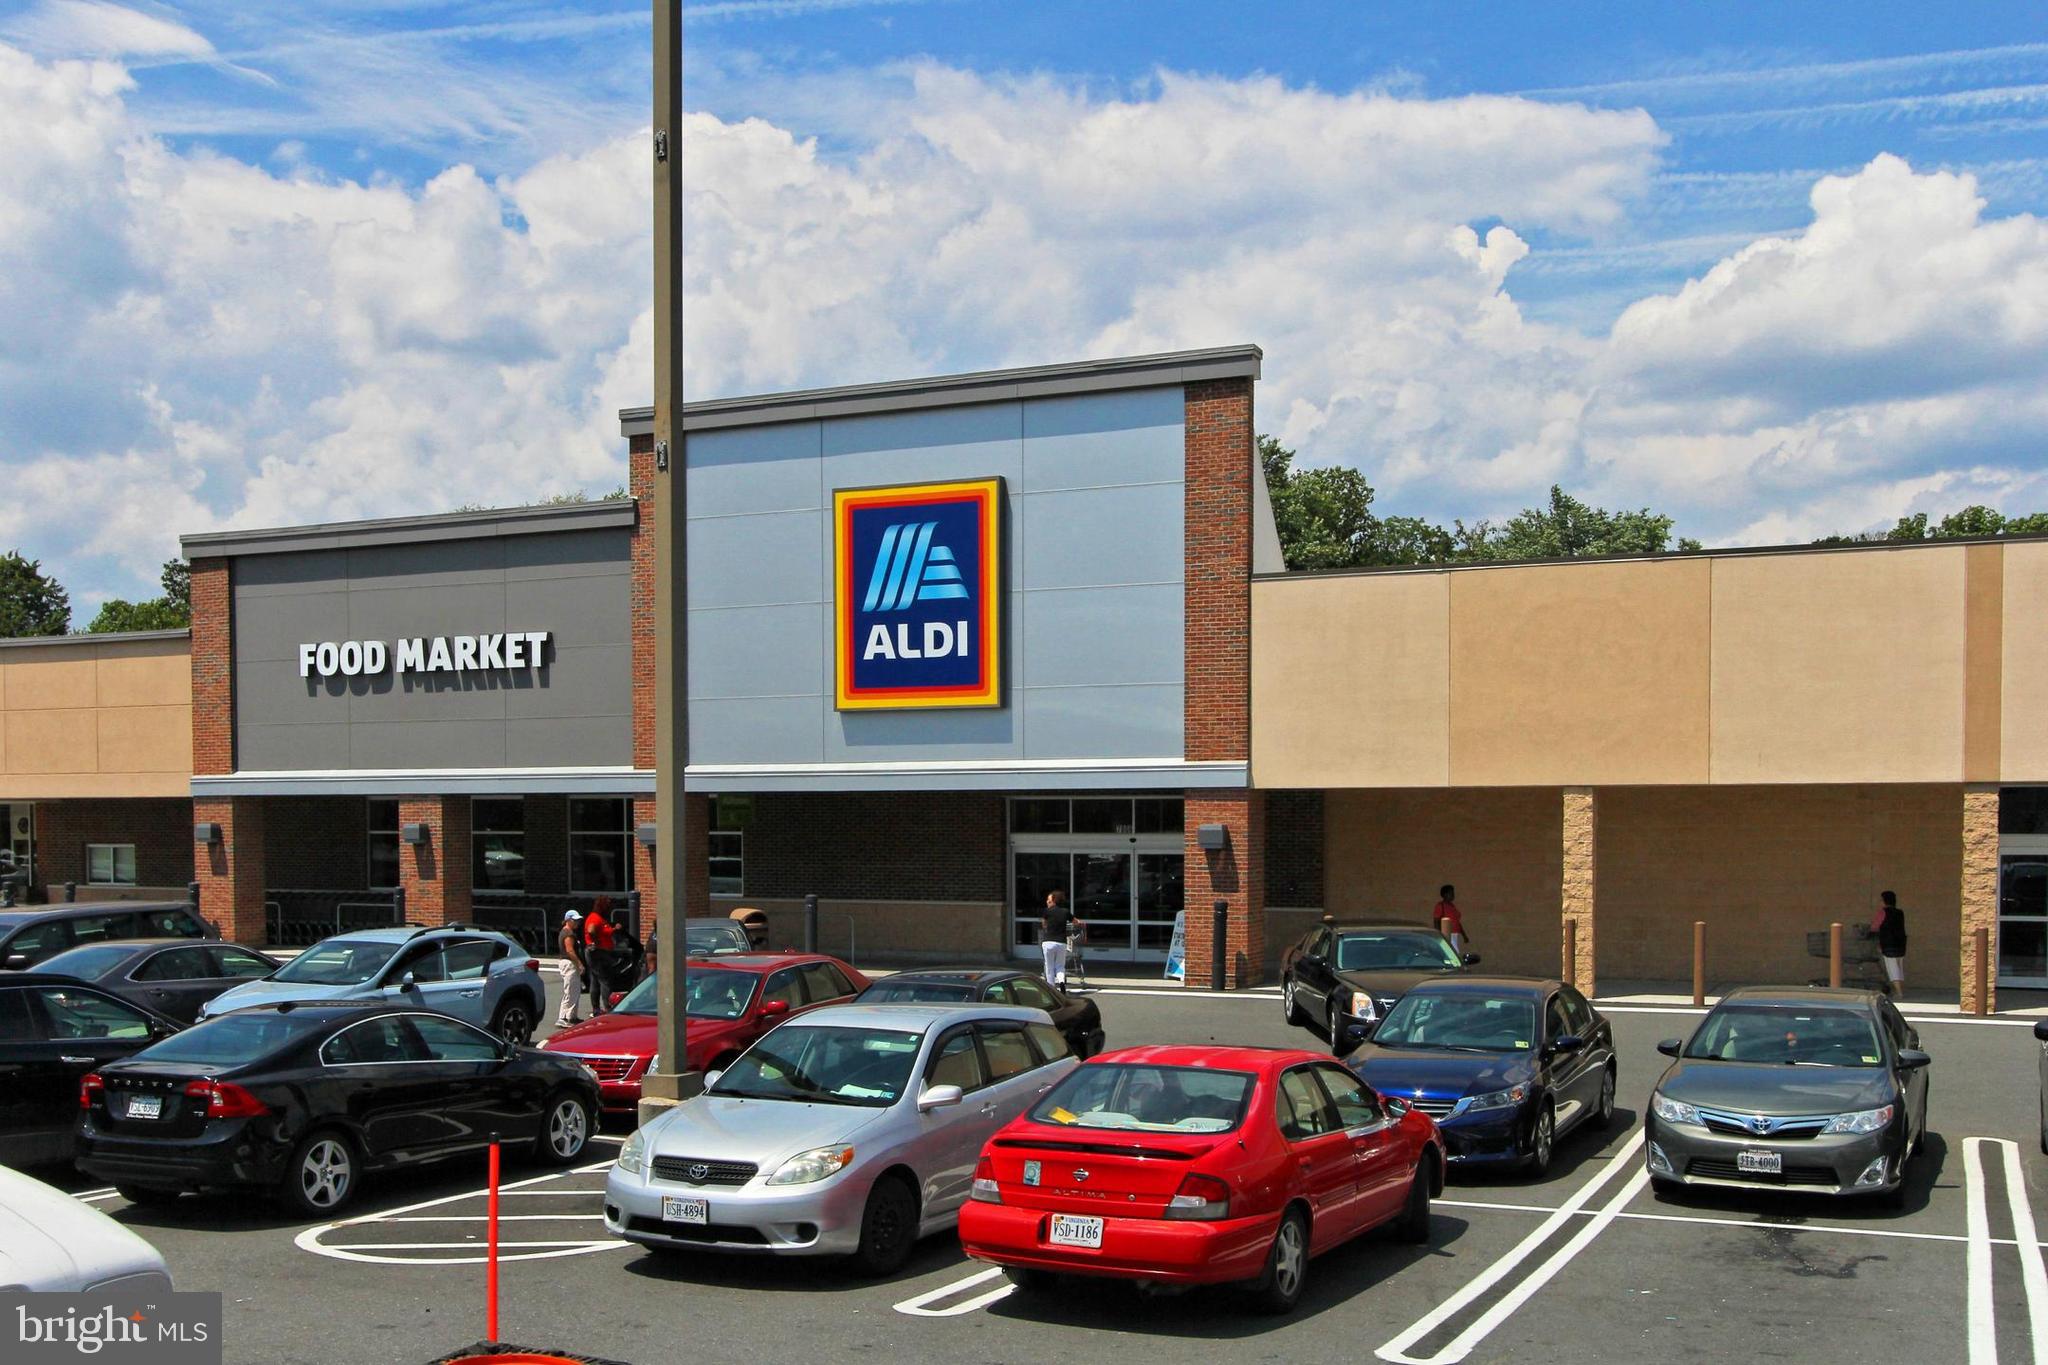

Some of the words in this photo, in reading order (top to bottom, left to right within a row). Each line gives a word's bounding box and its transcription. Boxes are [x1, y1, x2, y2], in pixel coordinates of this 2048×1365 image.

[863, 620, 969, 660] ALDI
[299, 640, 386, 677] FOOD
[396, 631, 548, 673] MARKET
[1053, 1188, 1106, 1199] ALTIMA
[665, 1203, 704, 1218] USH-4894
[1065, 1216, 1089, 1224] VIRGINIA
[1053, 1222, 1098, 1240] VSD-1186
